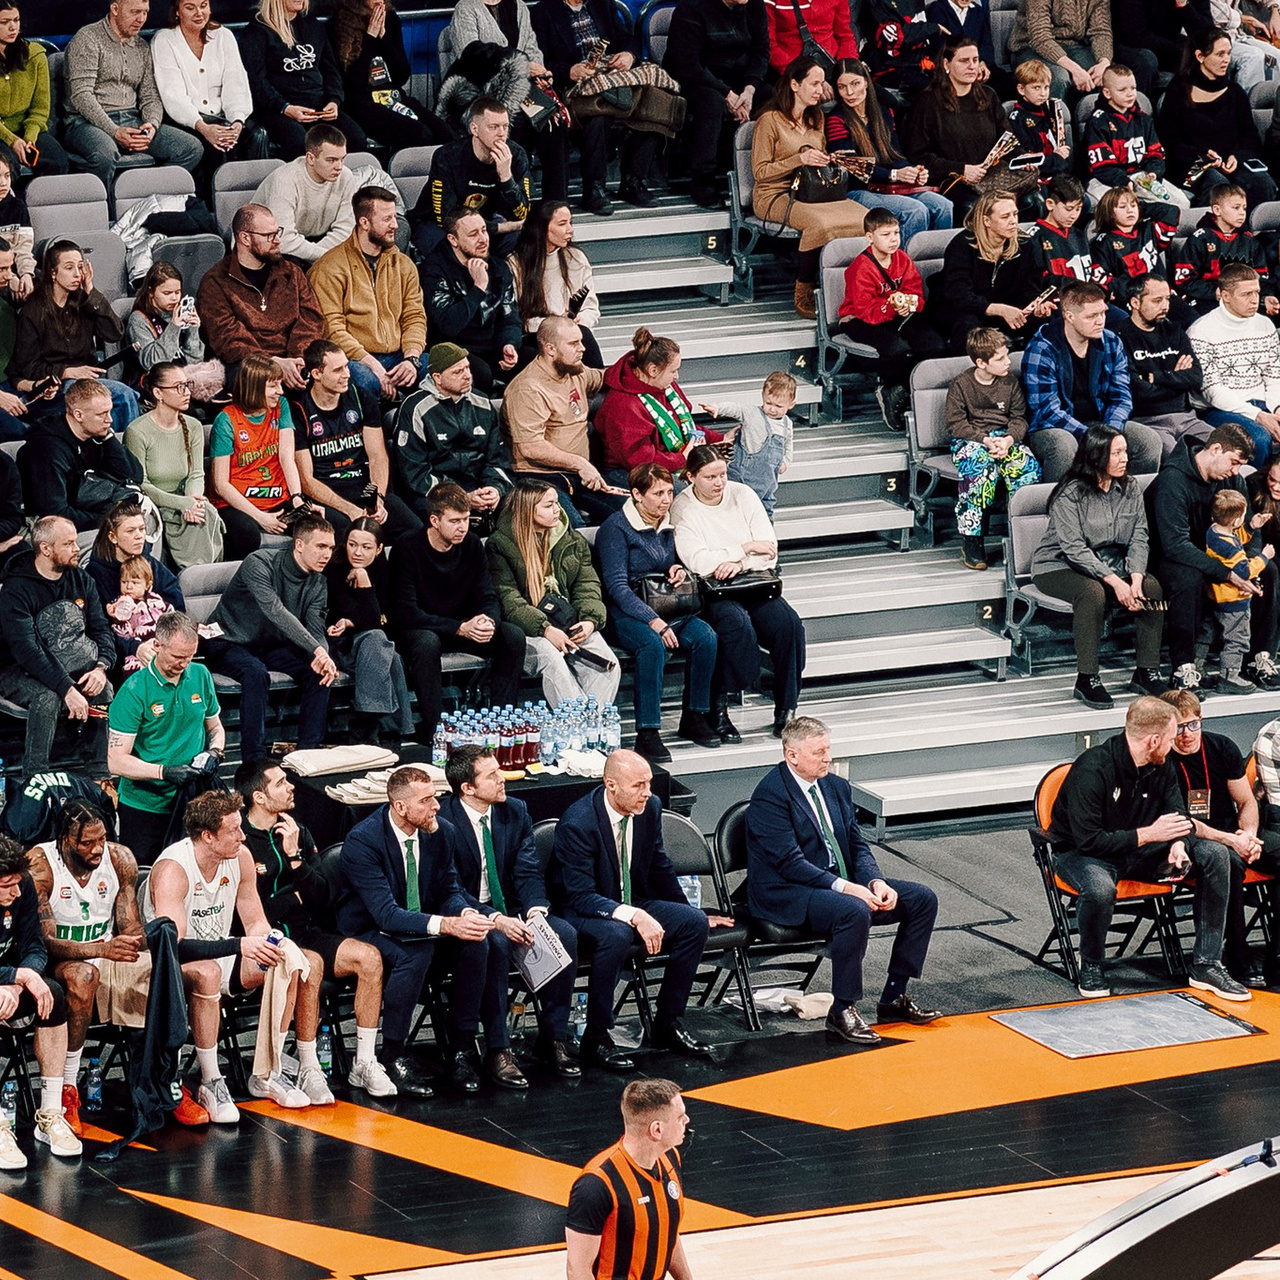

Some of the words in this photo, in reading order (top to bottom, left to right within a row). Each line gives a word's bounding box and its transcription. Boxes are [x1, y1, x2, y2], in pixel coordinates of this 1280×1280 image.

[707, 236, 717, 250] 5
[795, 354, 807, 368] 4
[886, 477, 897, 492] 3
[982, 605, 993, 619] 2
[1083, 734, 1091, 749] 1
[79, 901, 90, 921] 3
